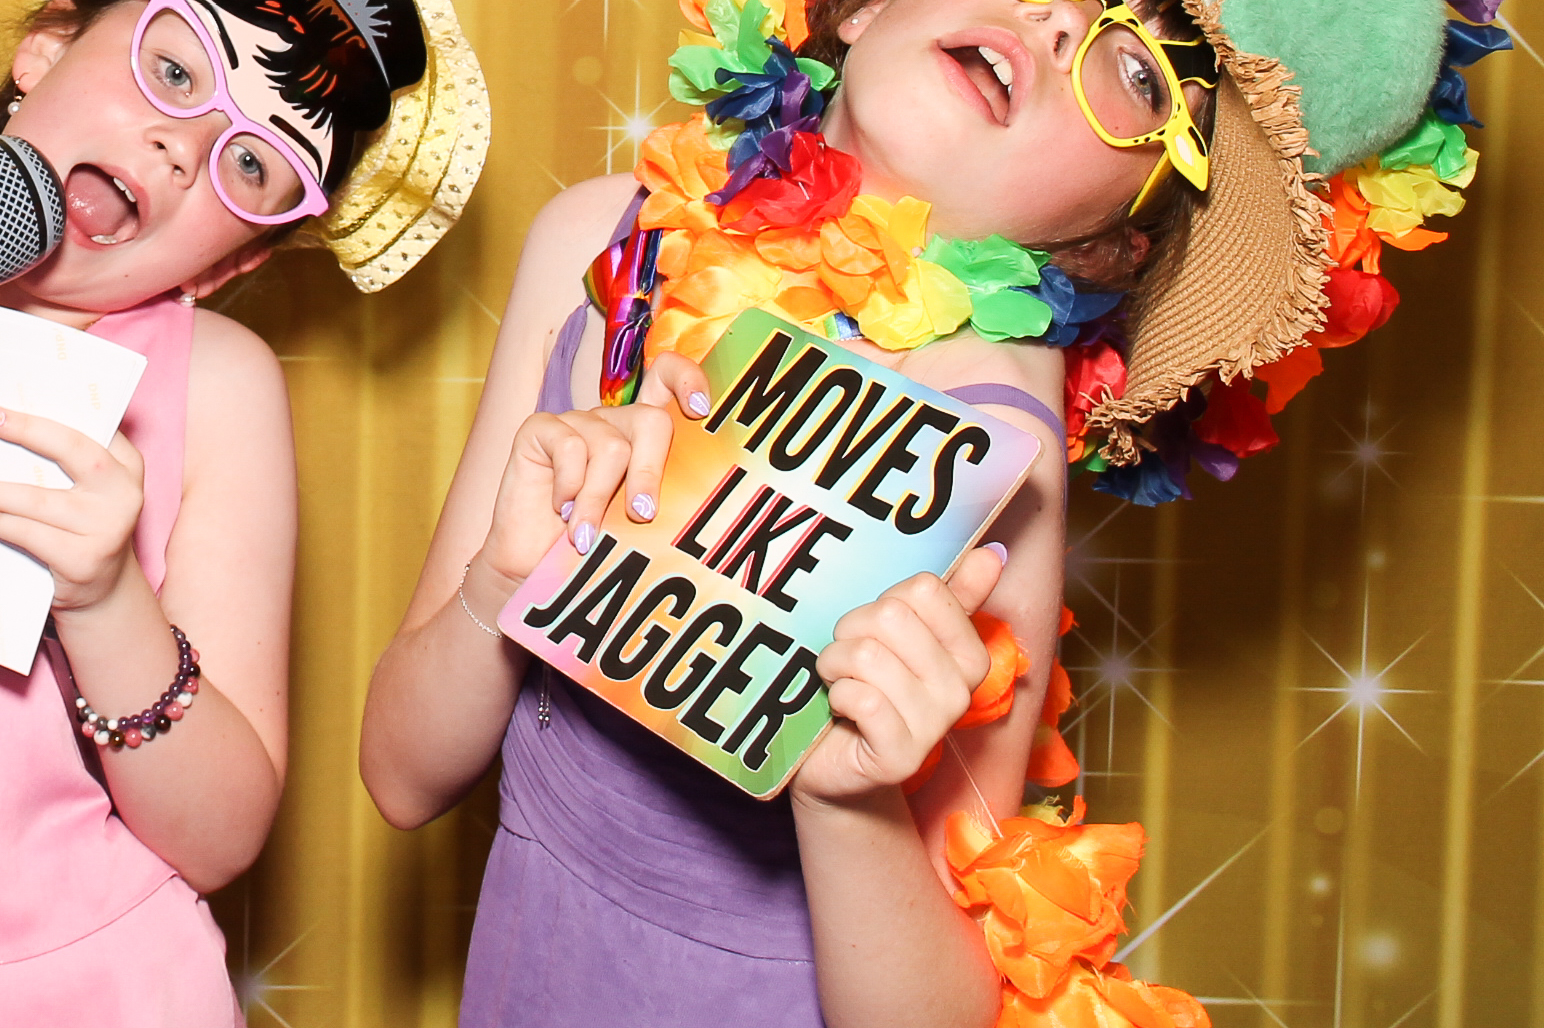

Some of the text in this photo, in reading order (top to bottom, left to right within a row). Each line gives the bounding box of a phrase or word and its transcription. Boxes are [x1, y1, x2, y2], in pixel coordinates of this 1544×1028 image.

[88, 383, 102, 410] DNP
[702, 328, 991, 535] MOVES
[670, 464, 853, 613] LIKE
[523, 529, 822, 771] JAGGER
